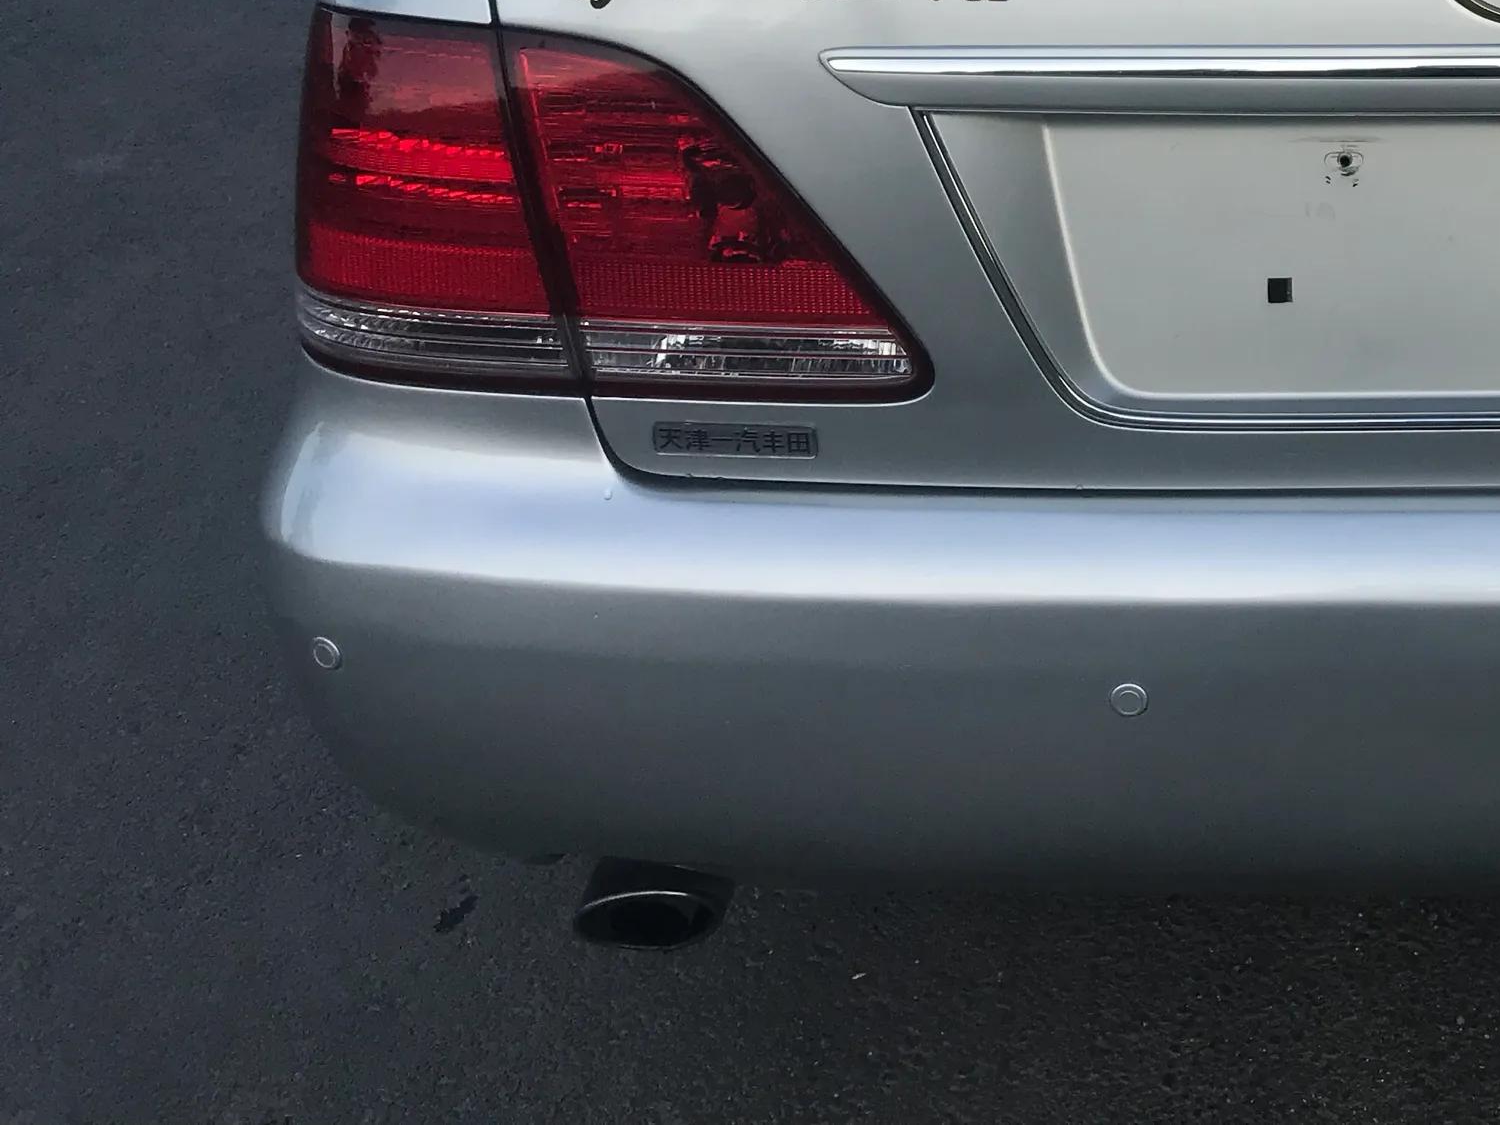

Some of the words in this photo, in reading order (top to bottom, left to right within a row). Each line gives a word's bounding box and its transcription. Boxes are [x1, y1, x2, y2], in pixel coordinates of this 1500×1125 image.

[658, 427, 812, 454] 天津一汽丰田
